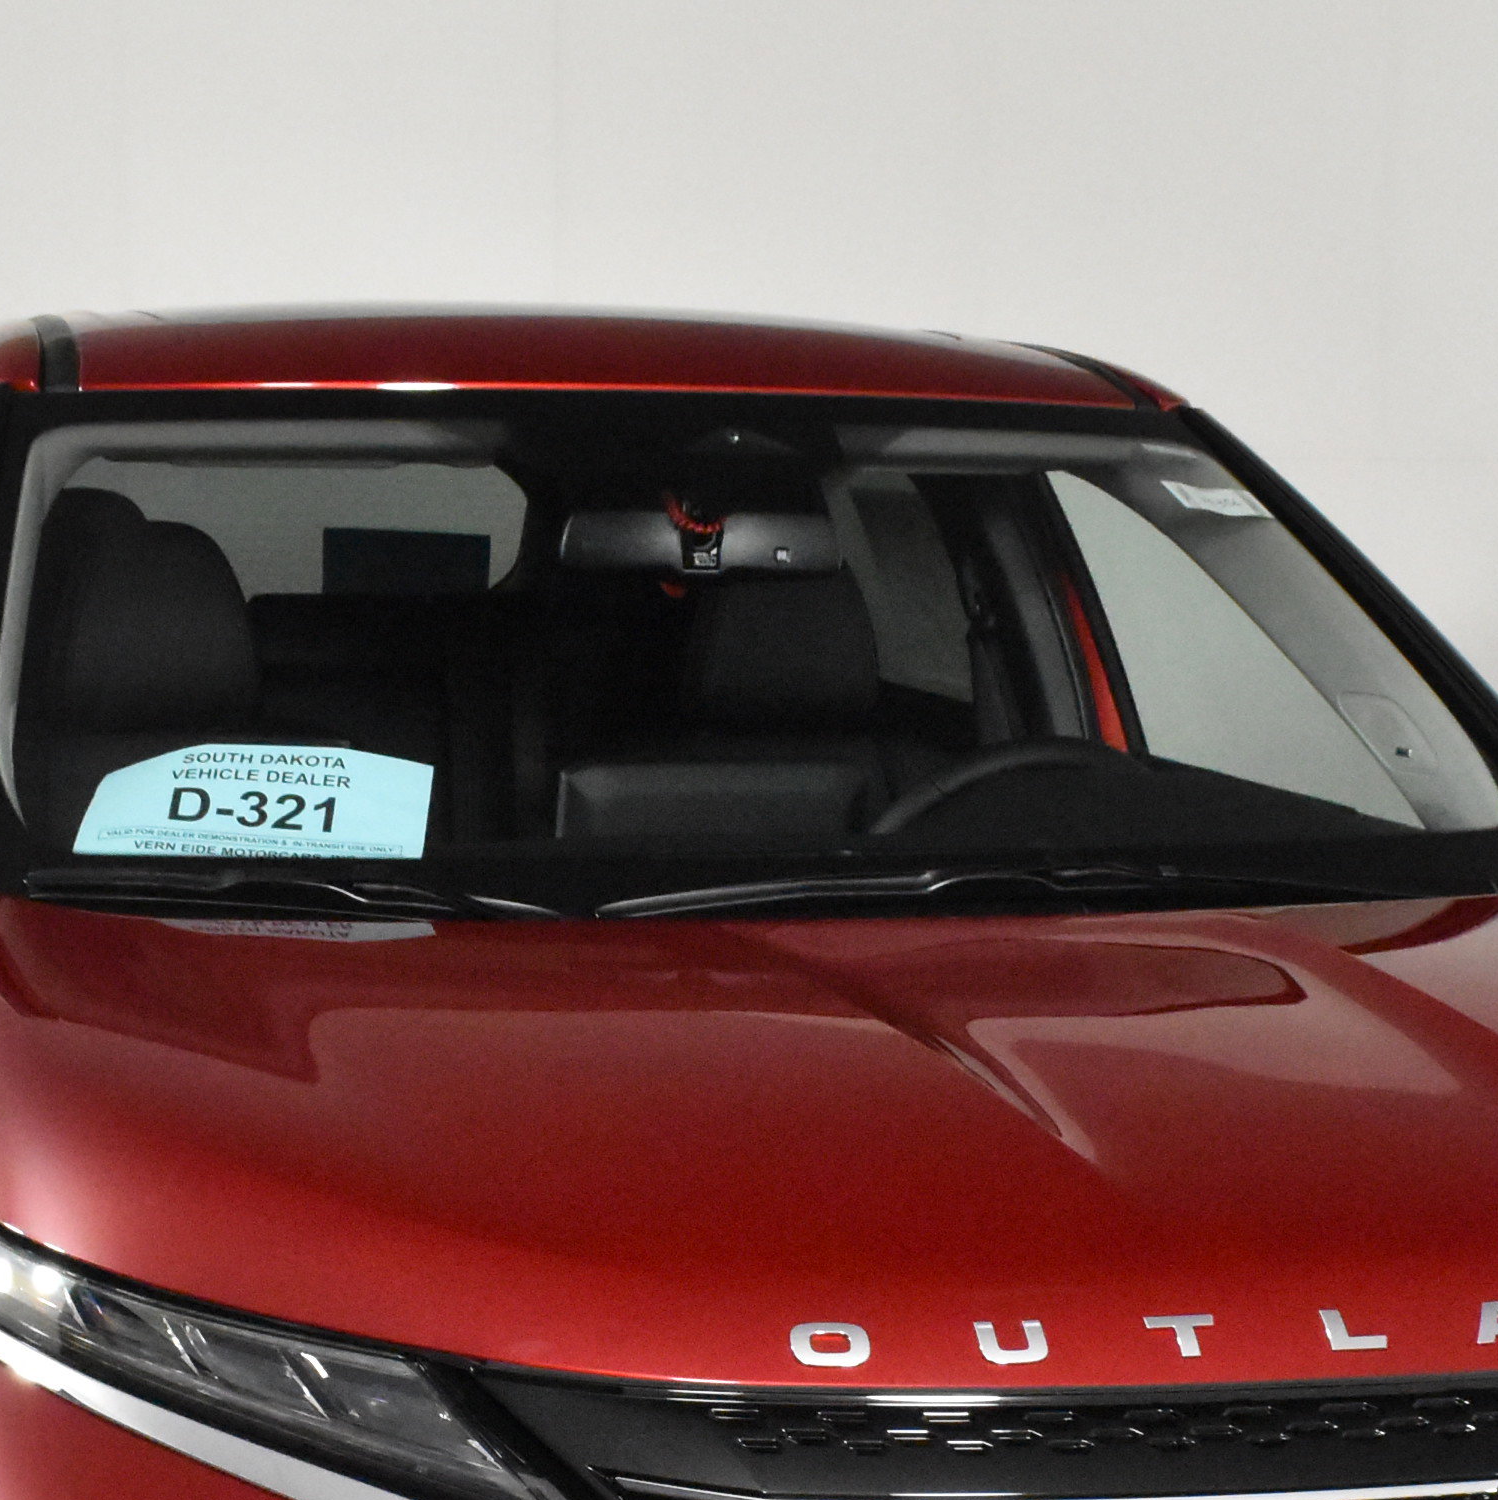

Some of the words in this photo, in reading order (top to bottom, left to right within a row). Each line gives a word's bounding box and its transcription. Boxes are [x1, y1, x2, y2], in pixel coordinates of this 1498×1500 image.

[183, 752, 253, 765] SOUTH
[260, 753, 346, 769] DAKOTA
[172, 768, 259, 782] VEHICLE
[266, 770, 351, 788] DEALER
[167, 787, 336, 833] D-321
[135, 828, 154, 836] FOR
[157, 829, 194, 839] DEALER
[197, 833, 278, 845] DEMONSTRATION
[134, 840, 176, 851] VERN
[181, 844, 216, 856] EIDE
